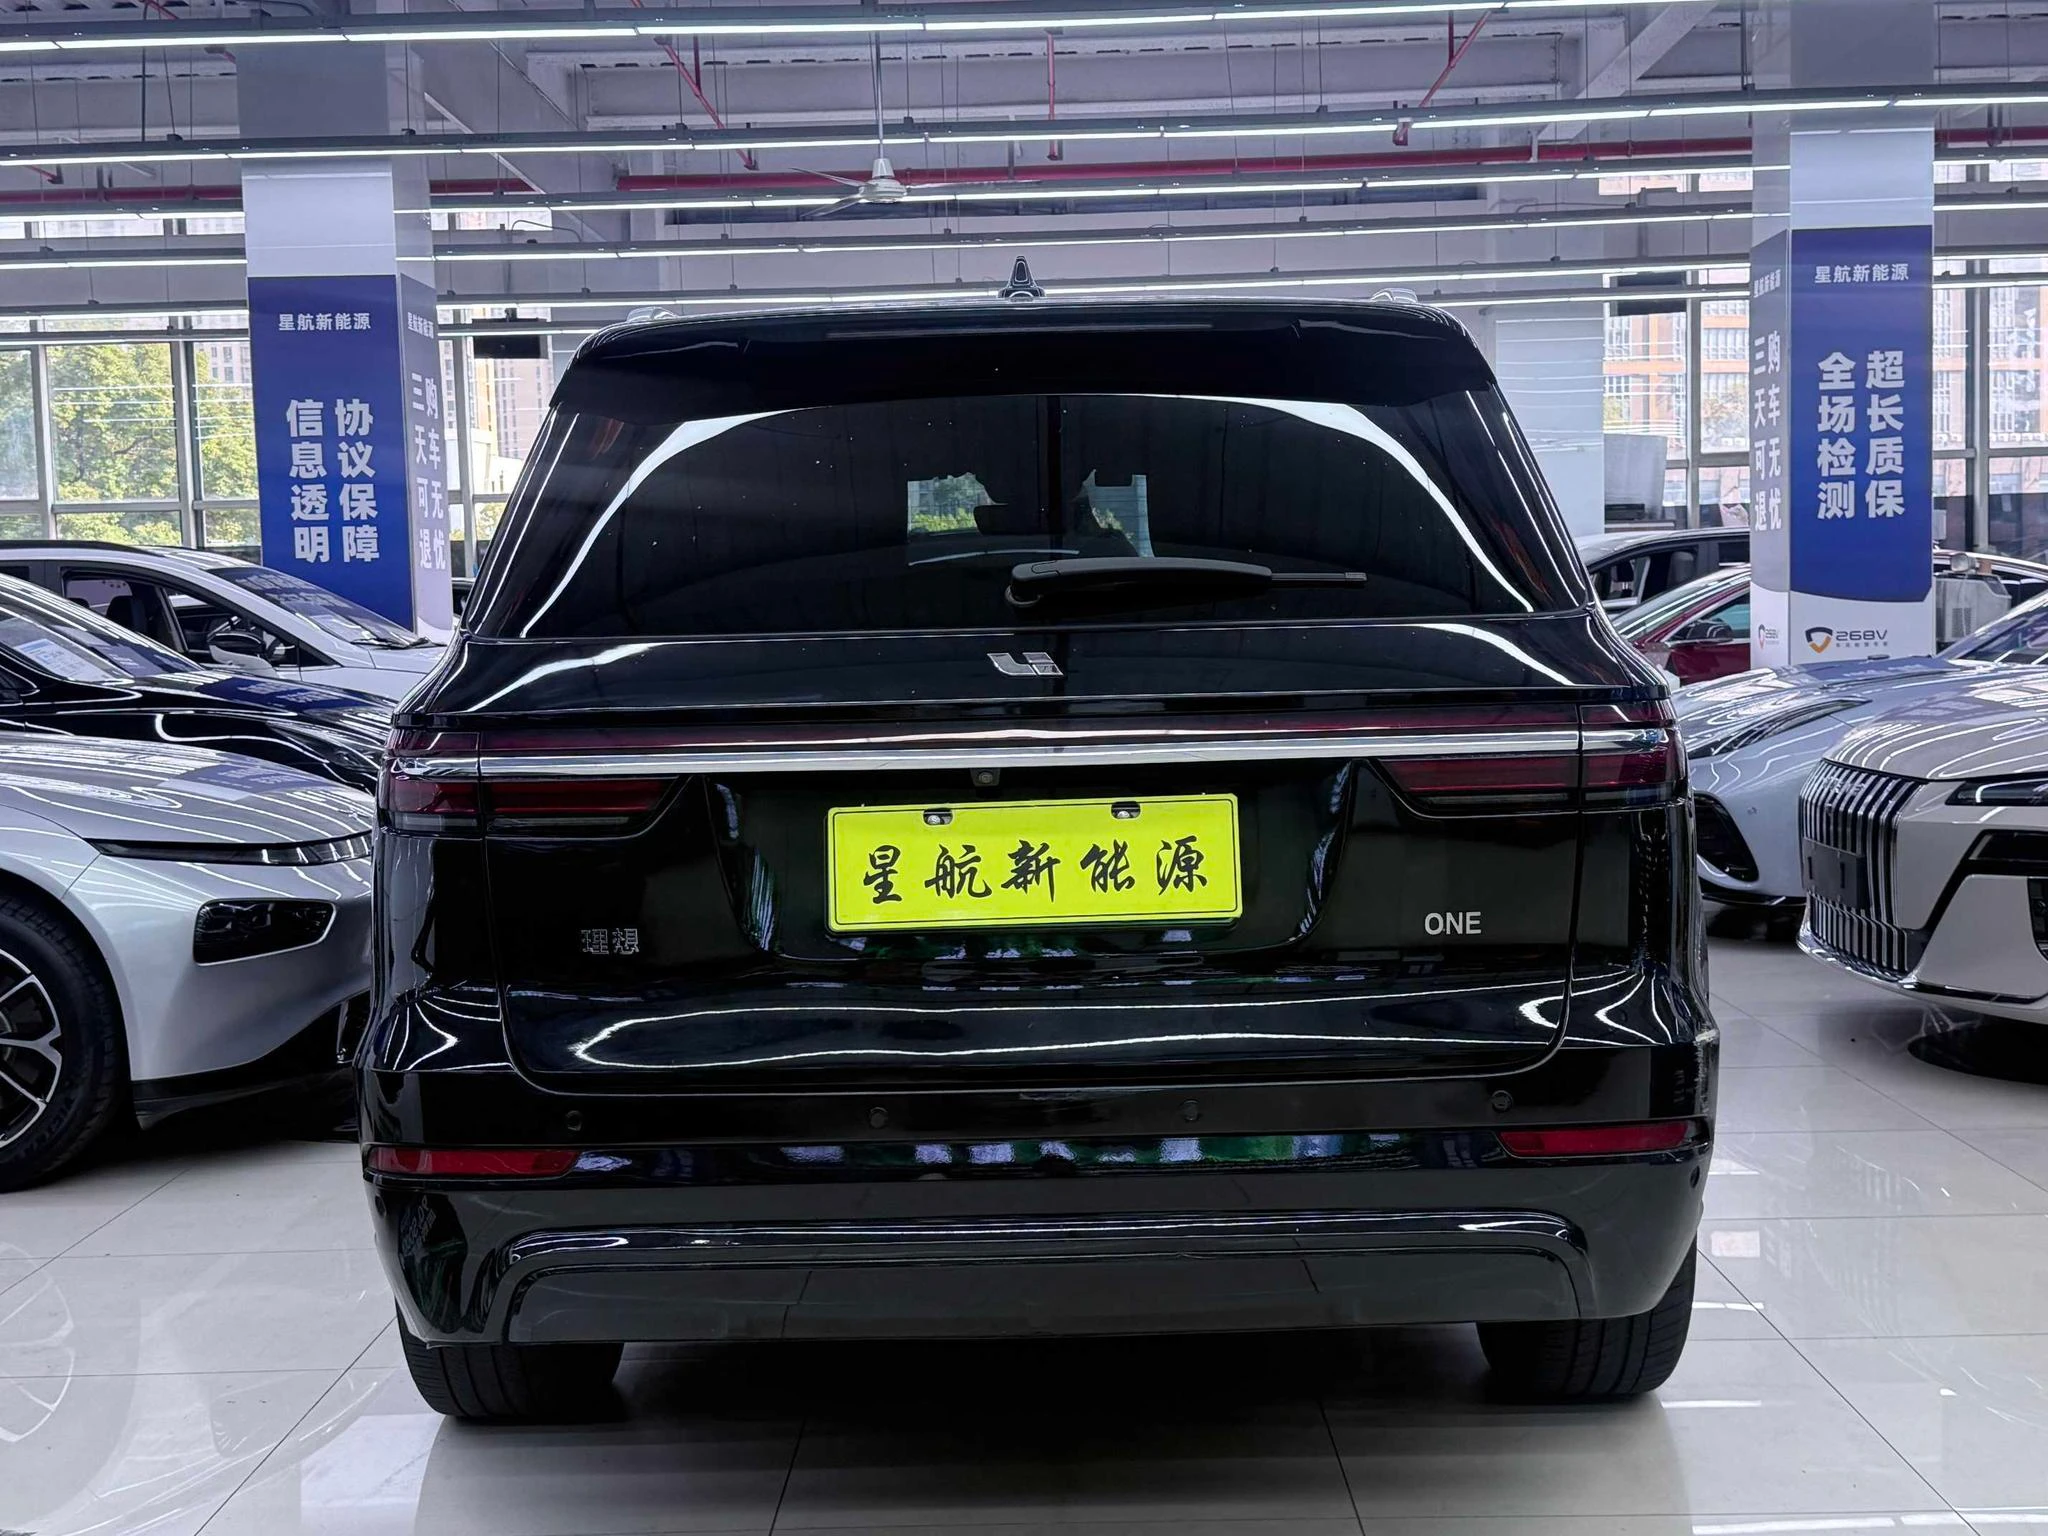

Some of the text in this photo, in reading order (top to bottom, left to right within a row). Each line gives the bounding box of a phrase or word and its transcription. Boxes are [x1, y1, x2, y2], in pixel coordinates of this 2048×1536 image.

[278, 313, 372, 331] 星航新能源
[1814, 263, 1909, 283] 星航新能源
[286, 398, 330, 564] 信息透明
[334, 398, 380, 563] 协议保障
[411, 373, 432, 569] 三天可退
[425, 376, 446, 570] 购车无忧
[1753, 336, 1768, 532] 三天可退
[1767, 329, 1782, 531] 购车无忧
[1817, 351, 1857, 520] 全场检测
[1865, 350, 1905, 519] 超长质保
[1836, 629, 1888, 641] 268V
[581, 927, 640, 955] 理想
[863, 835, 1208, 905] 星航新能源
[1424, 911, 1482, 935] ONE
